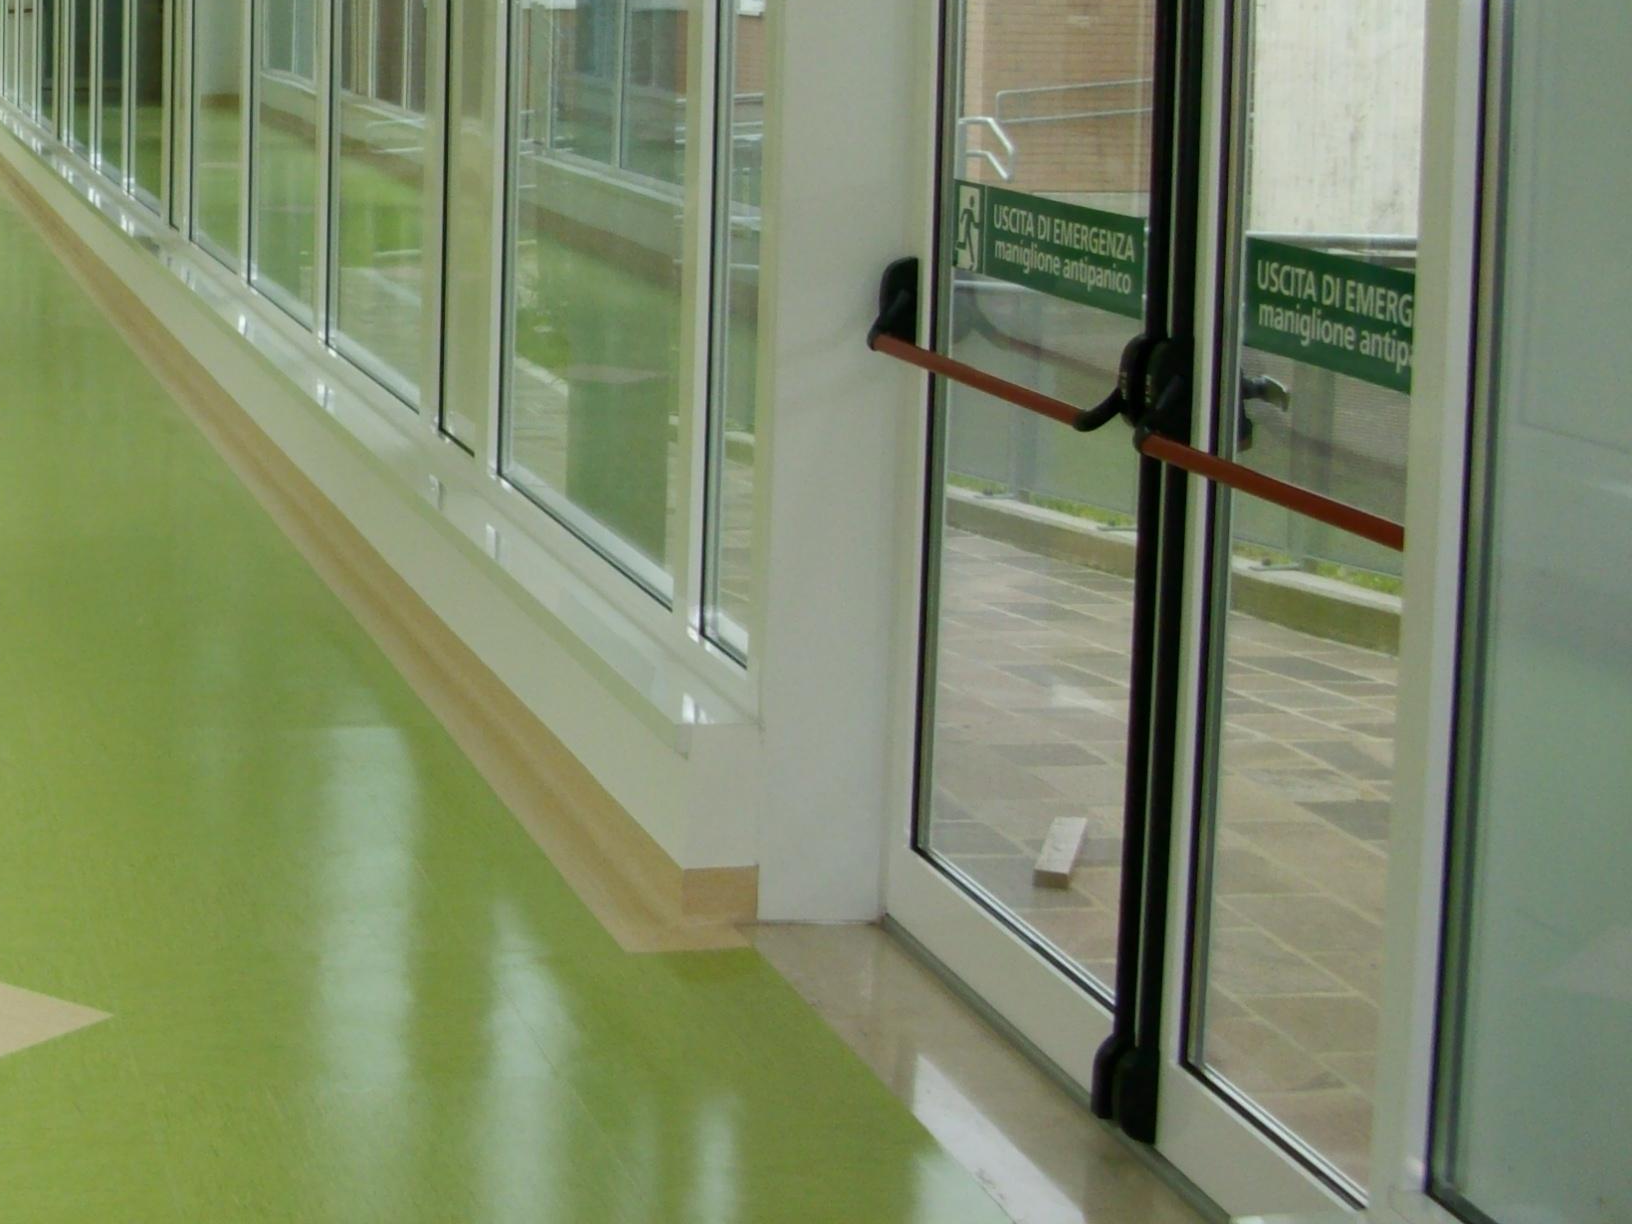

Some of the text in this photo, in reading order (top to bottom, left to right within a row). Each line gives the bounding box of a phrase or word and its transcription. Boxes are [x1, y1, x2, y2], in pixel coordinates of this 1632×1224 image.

[993, 203, 1136, 263] USCITA DI EMERGENZA
[994, 238, 1132, 295] maniglione antipanico
[1257, 259, 1317, 303] USCITA
[1321, 274, 1341, 309] DI
[1258, 303, 1356, 351] maniglione
